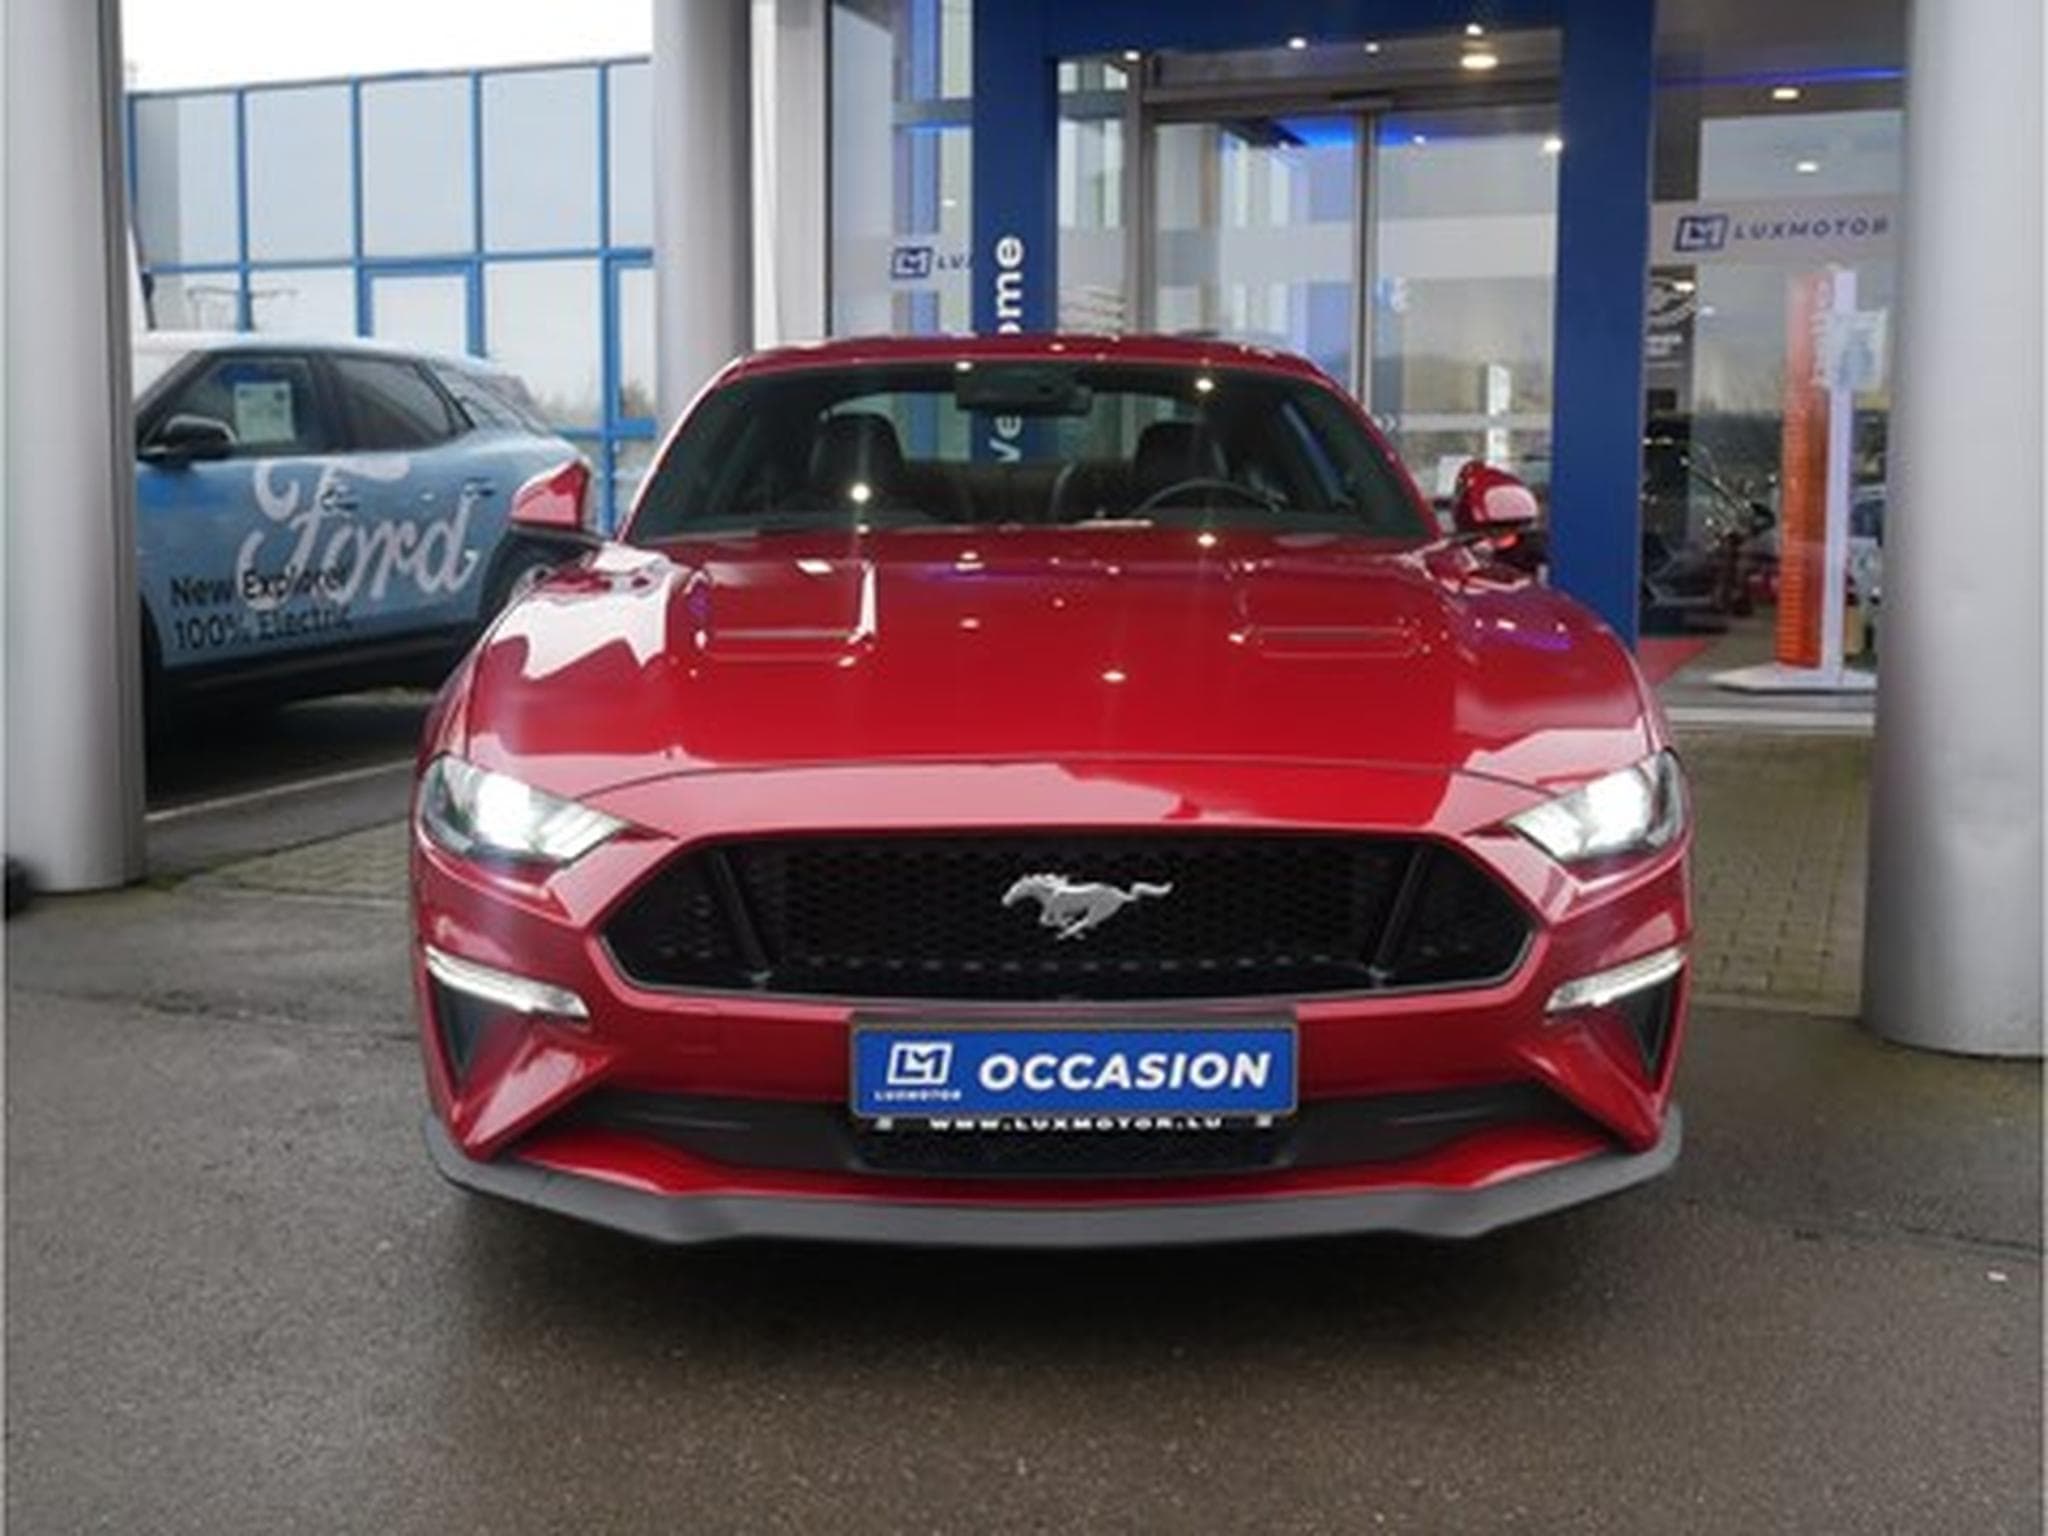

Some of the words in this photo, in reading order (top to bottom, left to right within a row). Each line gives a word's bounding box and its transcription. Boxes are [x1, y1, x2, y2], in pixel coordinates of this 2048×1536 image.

[1734, 217, 1889, 239] LUXMOTOR
[236, 459, 478, 610] Ford
[170, 576, 235, 607] New
[243, 566, 347, 599] Explorer
[175, 614, 252, 649] 100%
[257, 609, 352, 641] Electric
[978, 1053, 1271, 1091] OCCASION
